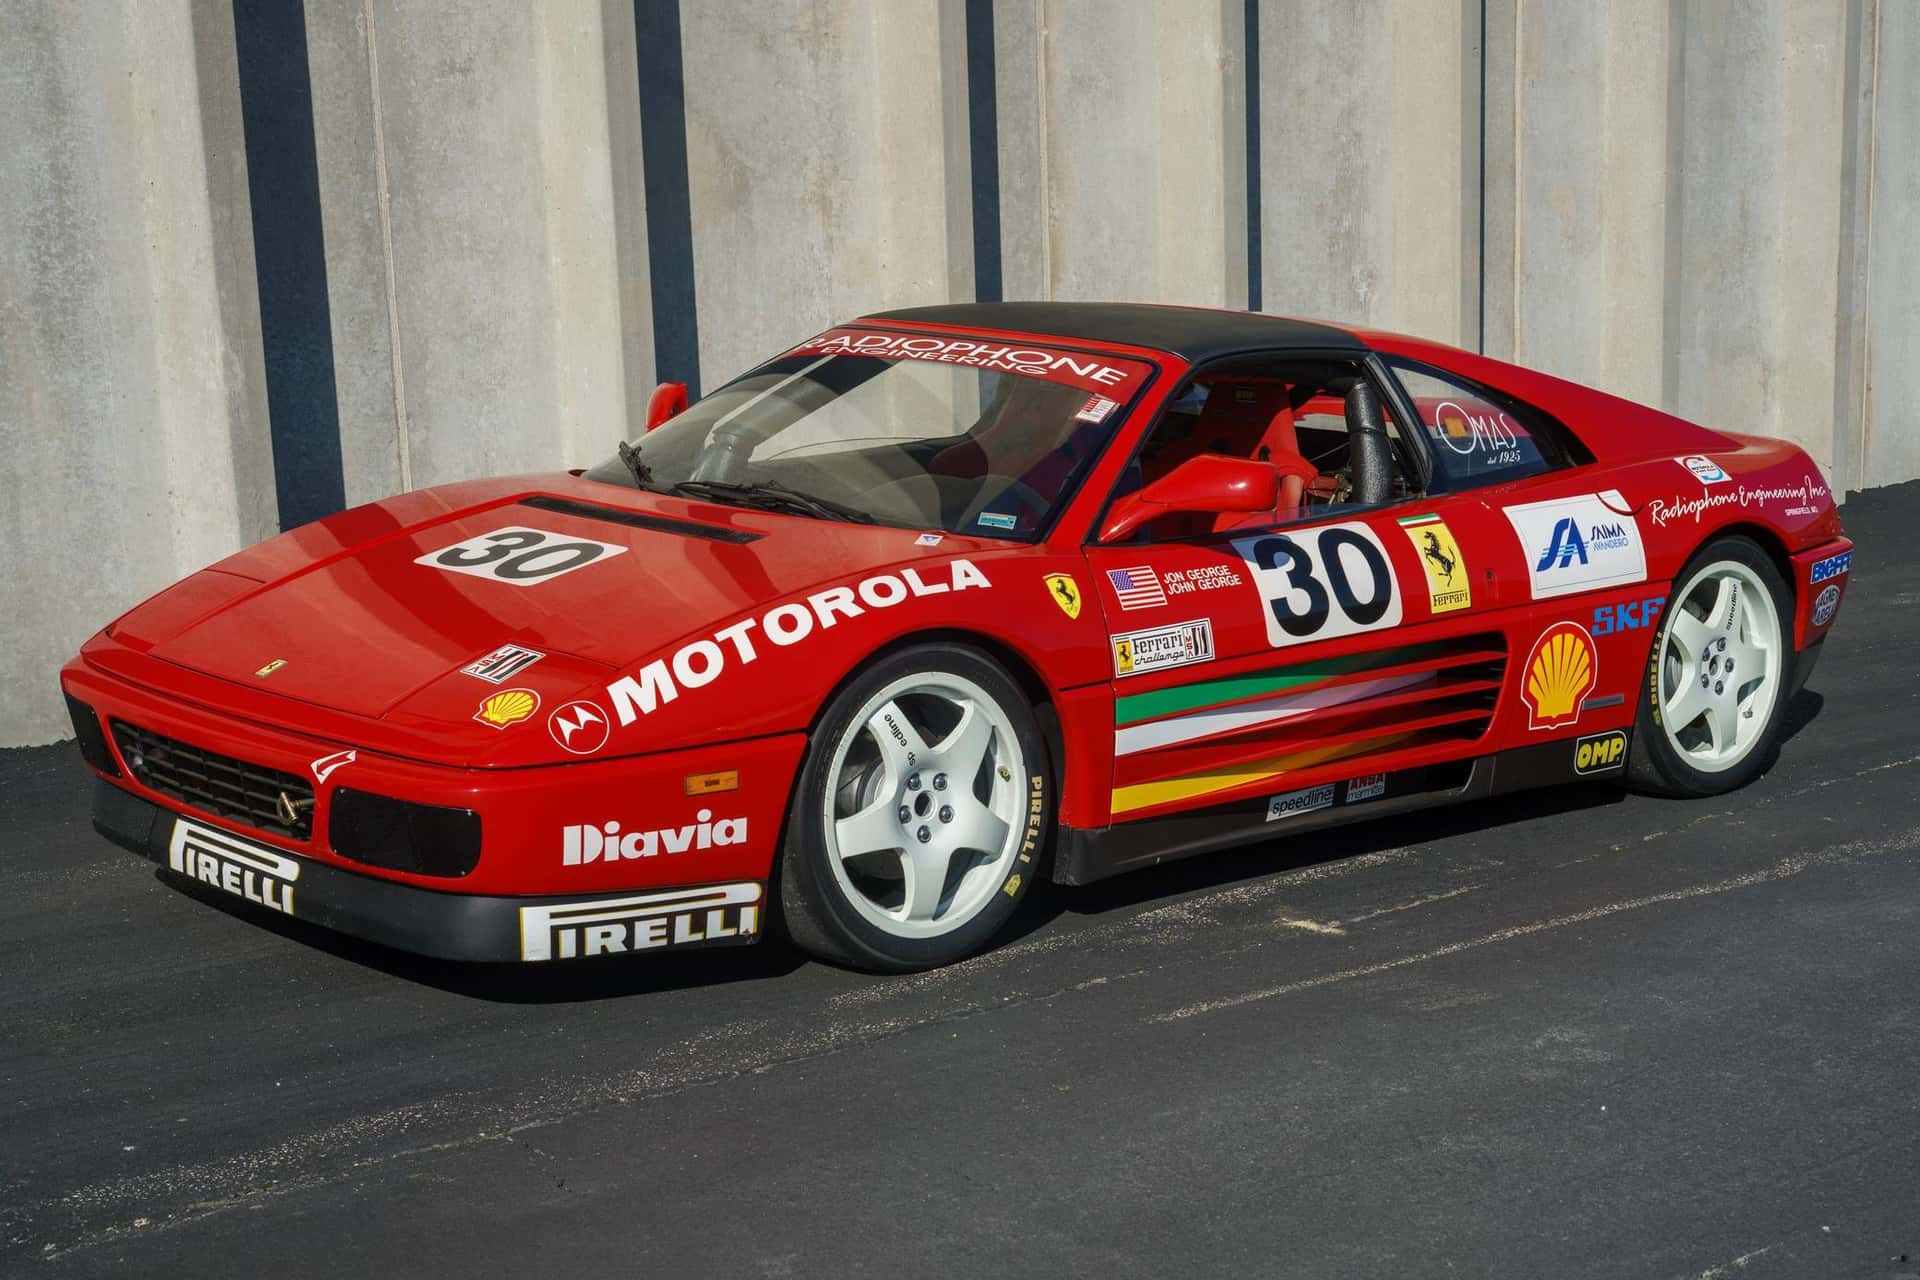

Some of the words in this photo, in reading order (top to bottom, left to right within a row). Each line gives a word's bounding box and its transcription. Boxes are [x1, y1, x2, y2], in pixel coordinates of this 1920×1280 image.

[820, 345, 1048, 376] ENGINEERING
[1436, 402, 1517, 454] OMAS
[1498, 449, 1521, 464] 1925
[1649, 487, 1739, 528] Radiophone
[1738, 482, 1807, 508] Engineering
[1591, 522, 1626, 541] SAIMA
[436, 530, 606, 580] 30
[1163, 570, 1185, 584] JON
[1186, 564, 1231, 580] GEORGE
[1167, 579, 1196, 596] JOHN
[1199, 574, 1243, 591] GEORGE
[1252, 527, 1393, 637] 30
[1432, 589, 1470, 608] Ferrari
[1592, 597, 1665, 636] SKF
[605, 558, 993, 728] MOTOROLA
[1131, 629, 1184, 655] Ferrari
[1649, 630, 1663, 705] PIRELLI
[1577, 737, 1625, 769] OMP
[1019, 775, 1043, 864] PIRELLI
[1271, 788, 1332, 816] speedline
[562, 808, 748, 867] Diavia
[169, 817, 301, 917] PIRELLI
[519, 881, 763, 962] PIRELLI
